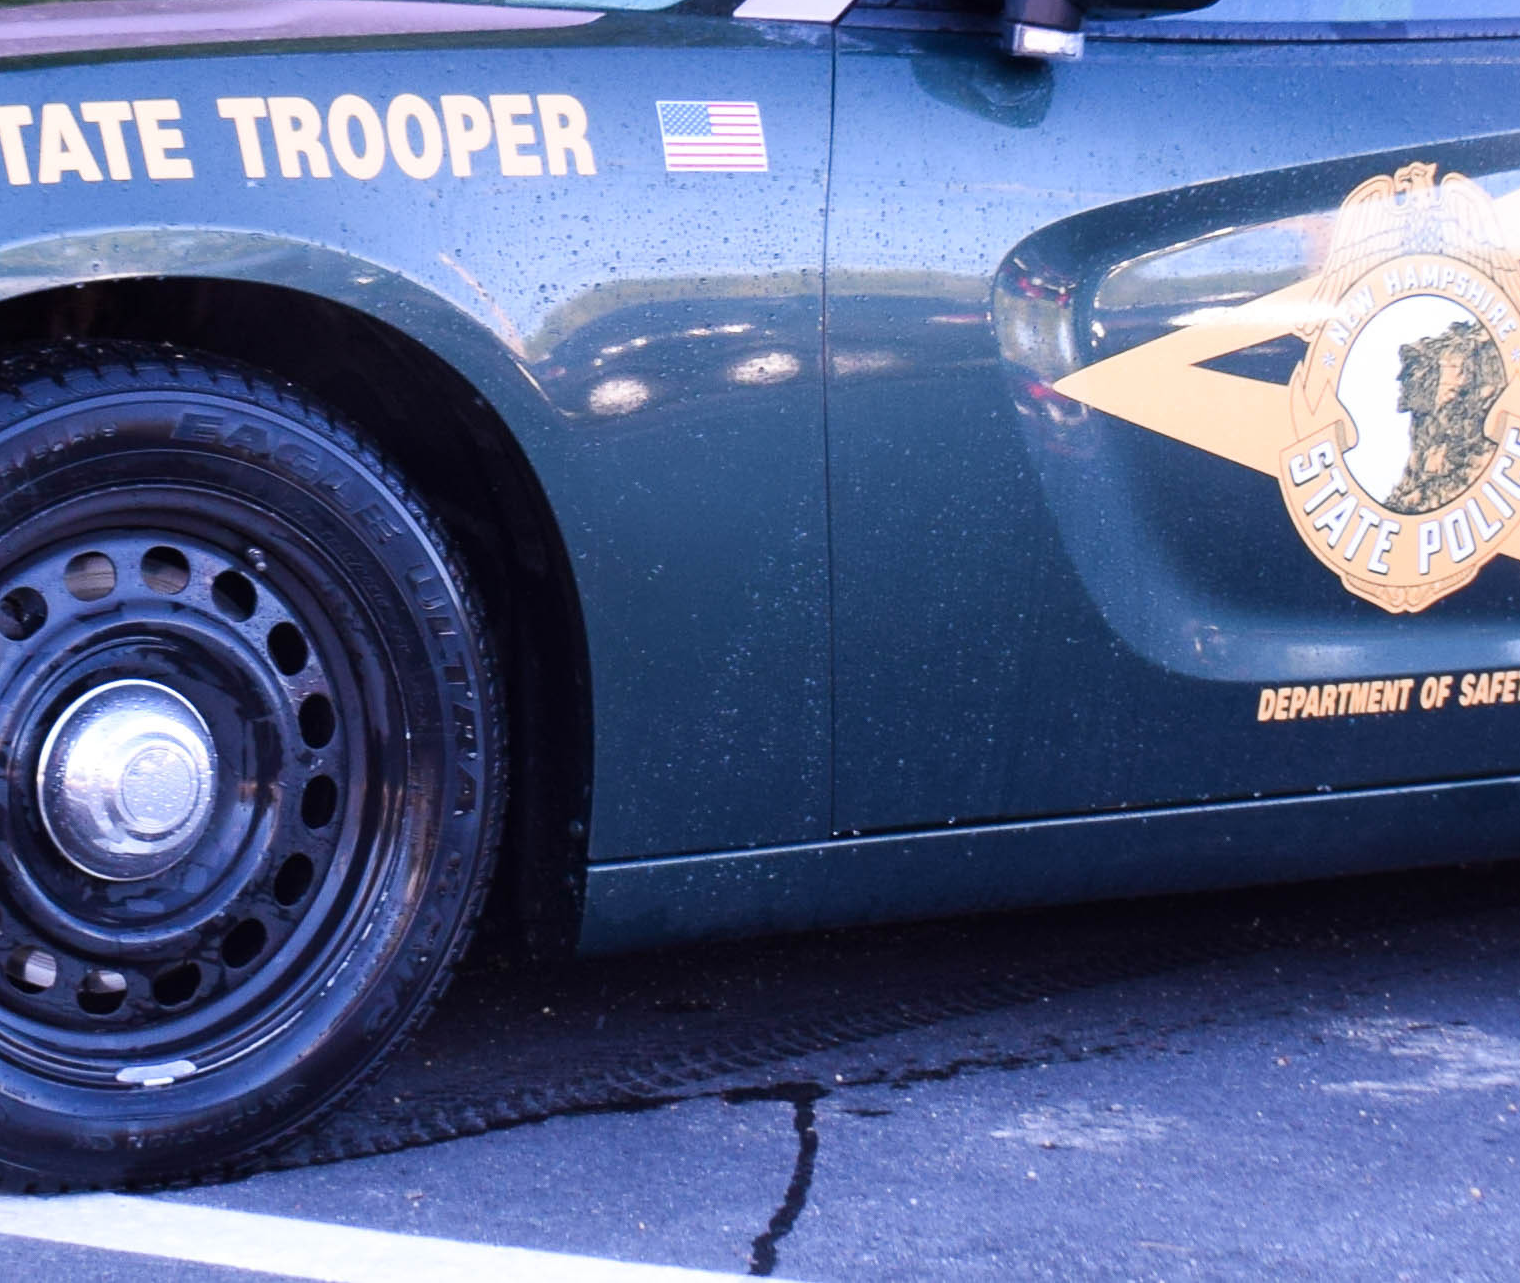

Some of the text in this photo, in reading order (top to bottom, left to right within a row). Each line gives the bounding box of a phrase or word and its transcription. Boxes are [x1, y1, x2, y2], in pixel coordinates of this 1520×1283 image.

[217, 93, 596, 178] TROOPER
[1329, 265, 1515, 345] NEW HAMPSHIRE
[1290, 443, 1400, 575] STATE
[1258, 679, 1412, 722] DEPARTMENT
[1421, 676, 1452, 710] OF
